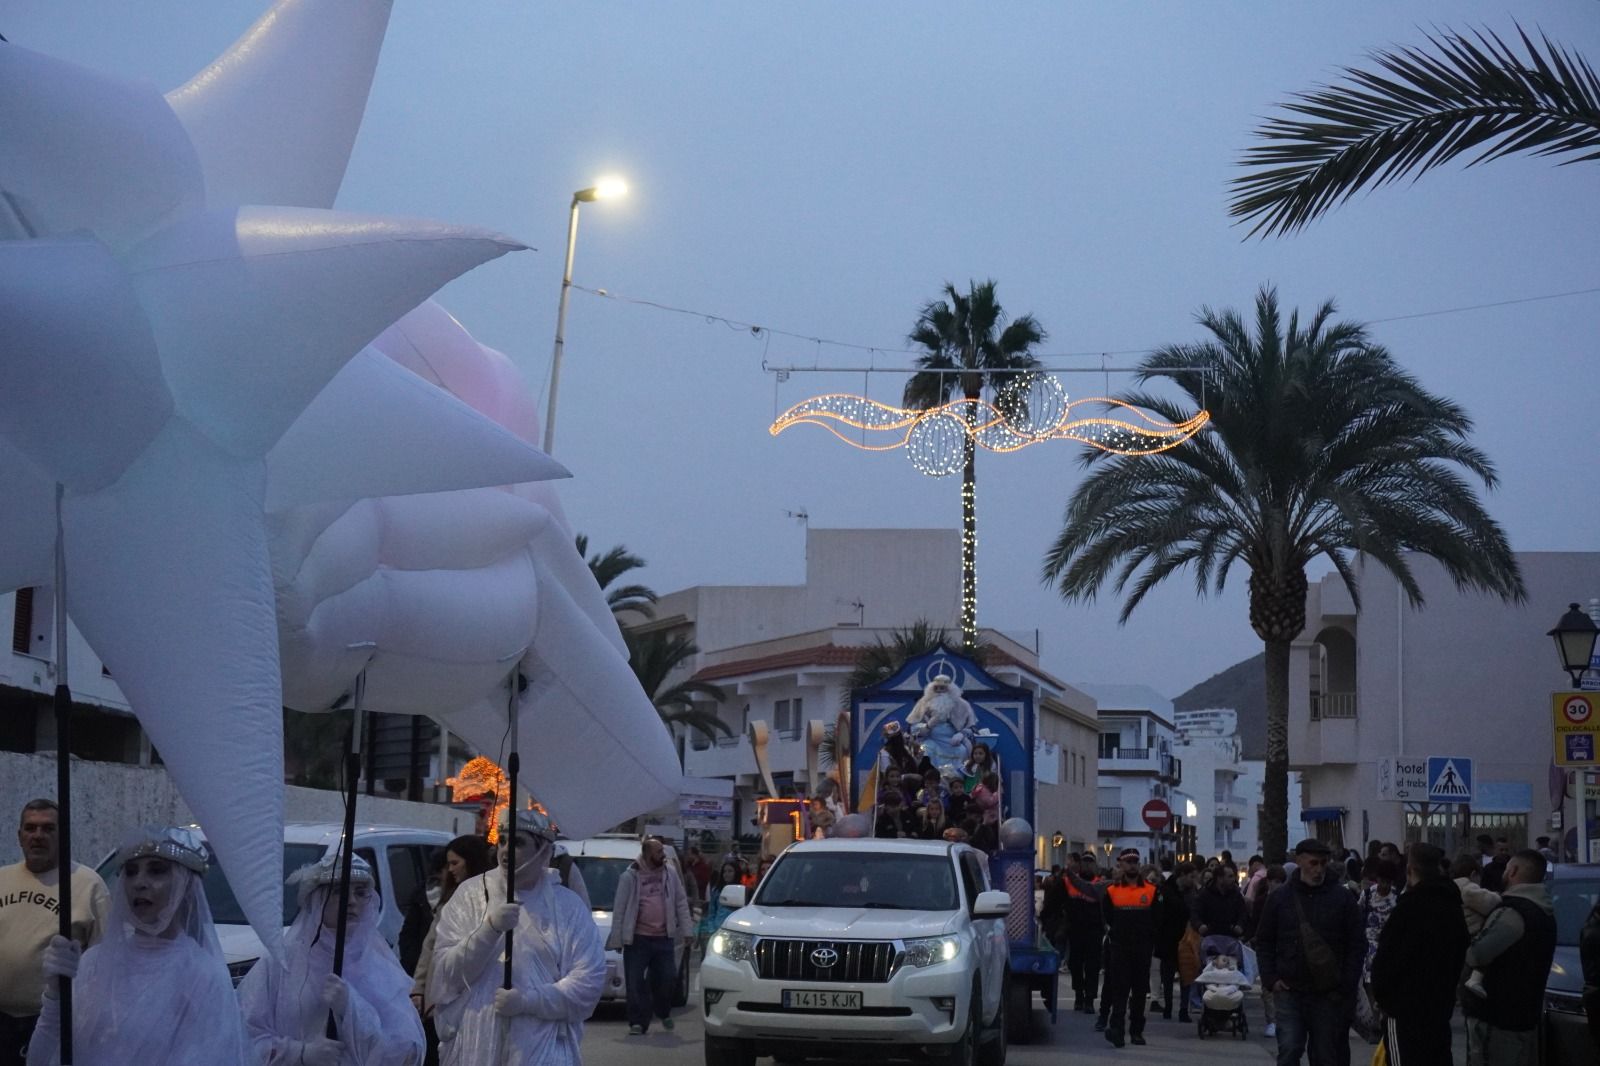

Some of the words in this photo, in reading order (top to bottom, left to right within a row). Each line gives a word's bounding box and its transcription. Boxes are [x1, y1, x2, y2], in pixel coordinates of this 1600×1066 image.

[1569, 705, 1587, 714] 30
[1396, 761, 1425, 774] hotel
[1397, 778, 1404, 787] el
[795, 993, 827, 1006] 1415
[832, 994, 857, 1008] KJK
